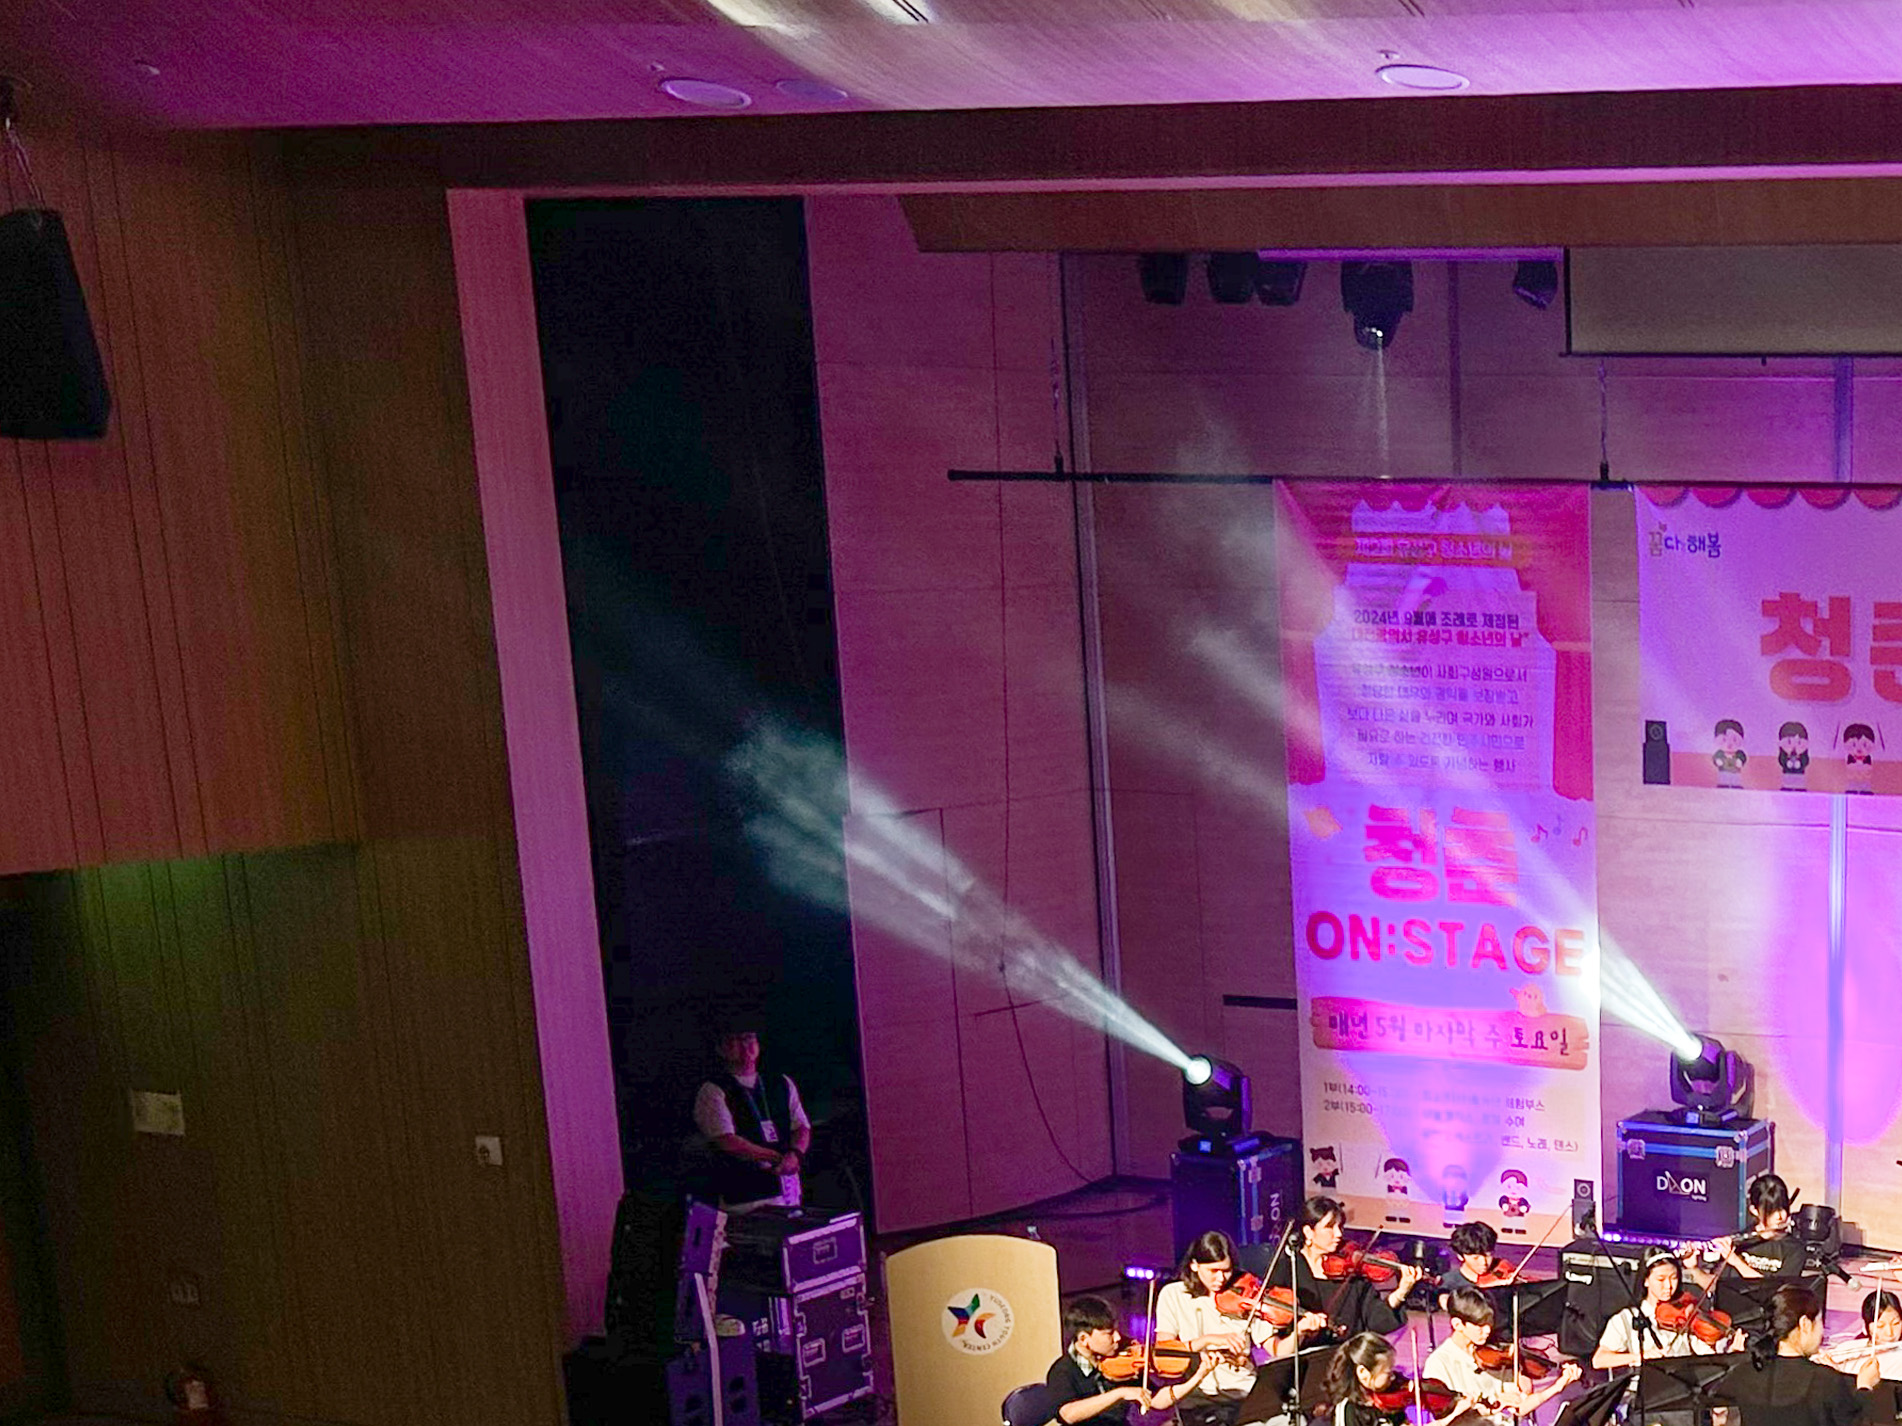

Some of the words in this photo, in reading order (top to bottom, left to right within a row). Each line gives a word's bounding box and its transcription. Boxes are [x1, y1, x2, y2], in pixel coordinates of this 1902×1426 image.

[1462, 711, 1496, 727] 국가와
[1305, 910, 1585, 977] ON:STAGE
[1328, 1010, 1368, 1040] 매년
[1375, 1014, 1406, 1042] 5월
[1484, 1023, 1501, 1049] 주
[1510, 1026, 1570, 1056] 토요일
